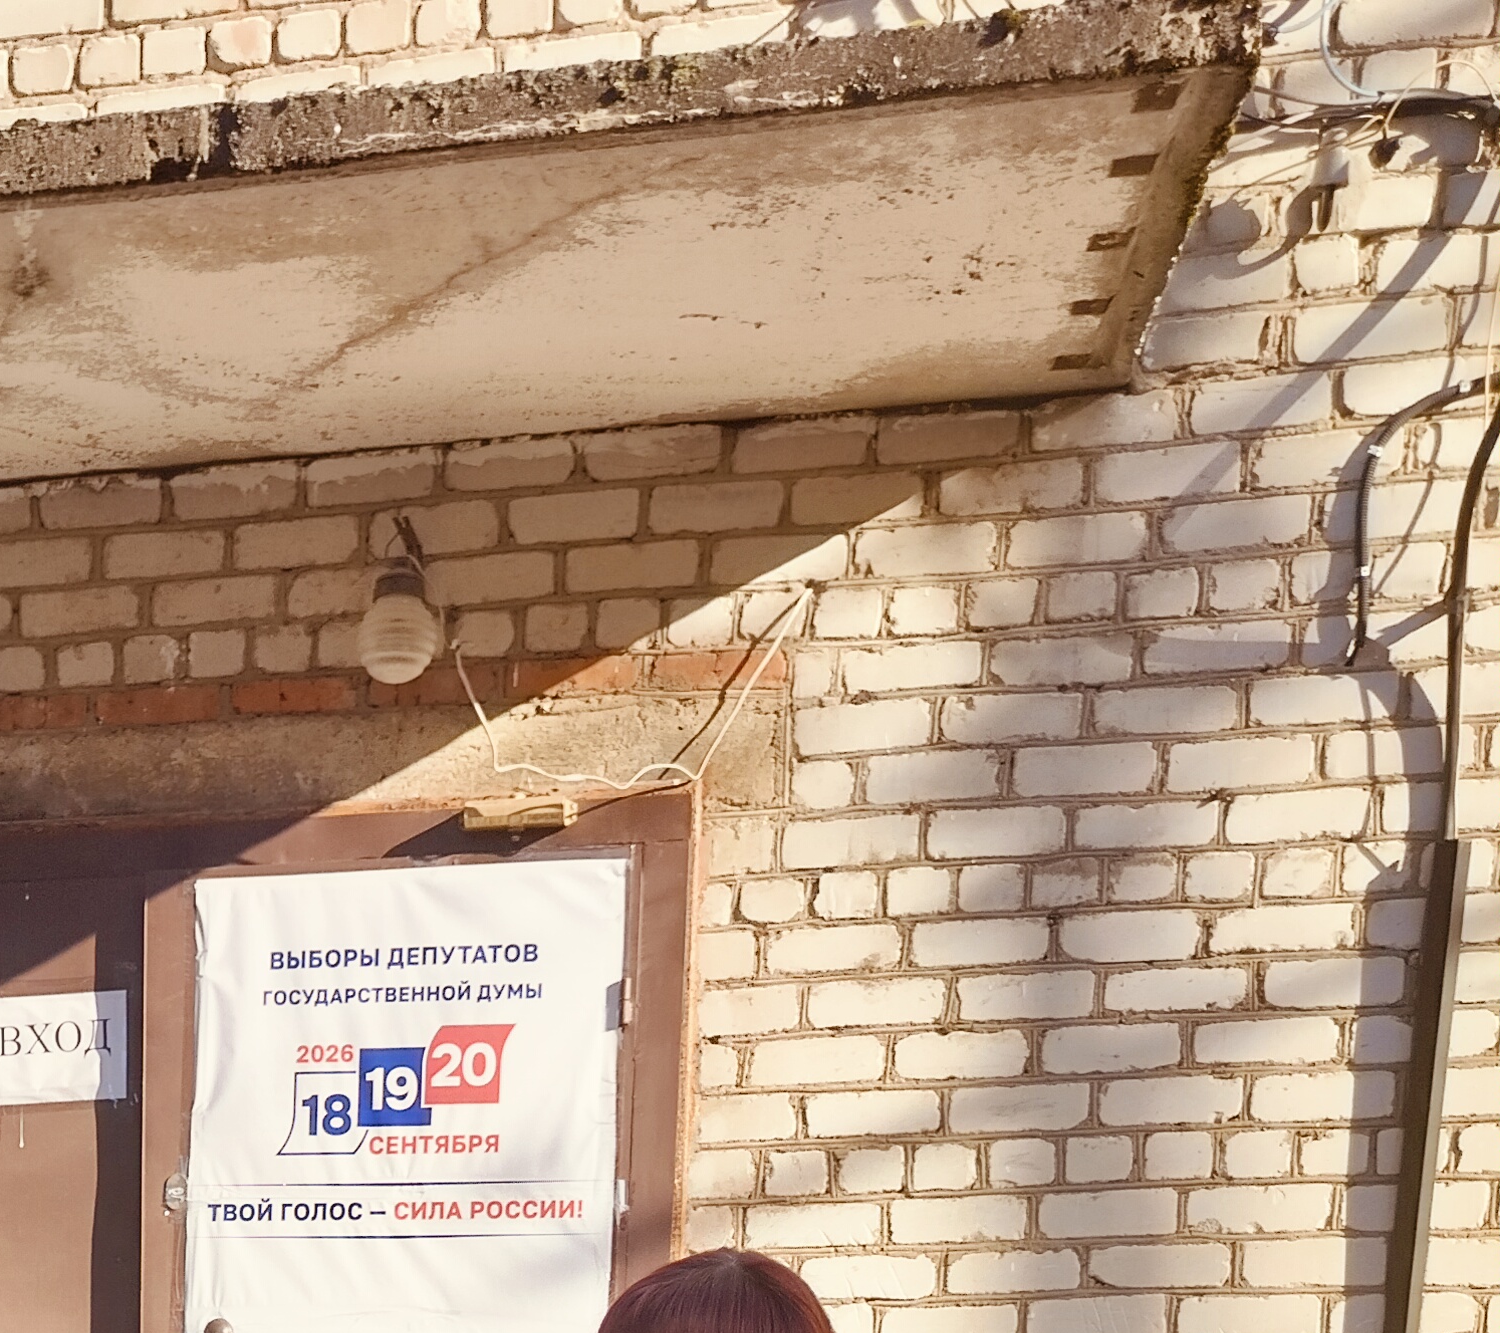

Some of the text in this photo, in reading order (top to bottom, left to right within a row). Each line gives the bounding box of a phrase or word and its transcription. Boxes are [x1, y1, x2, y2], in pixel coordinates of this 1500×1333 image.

[270, 943, 539, 970] ВЫБОРЫ ДЕПУТАТОВ
[263, 981, 543, 1006] ГОСУДАРСТВЕННОЙ ДУМЫ
[295, 1044, 354, 1063] 2026
[430, 1041, 497, 1088] 20
[365, 1065, 419, 1111] 19
[301, 1094, 351, 1137] 18
[368, 1134, 500, 1155] СЕНТЯБРЯ
[207, 1199, 273, 1222] ТВОЙ
[282, 1201, 363, 1222] ГОЛОС
[394, 1200, 463, 1221] СИЛА
[470, 1199, 583, 1221] РОССИИ!
